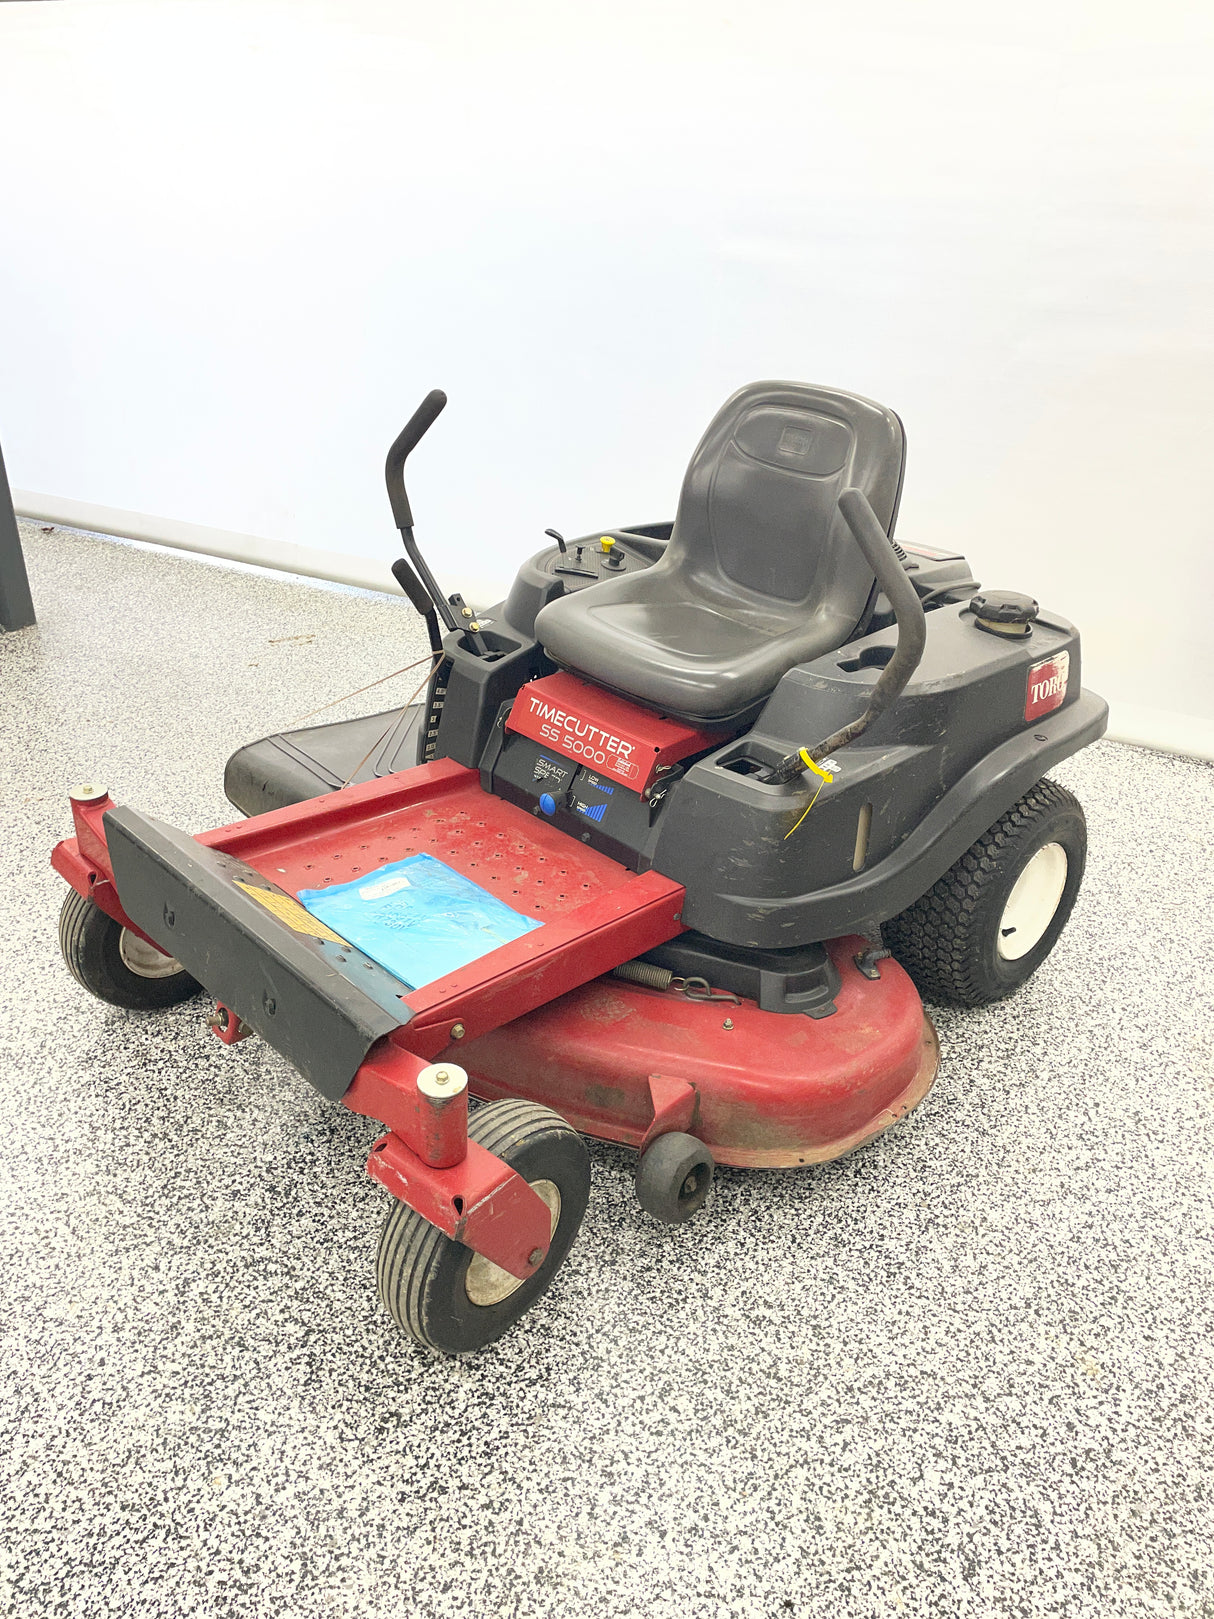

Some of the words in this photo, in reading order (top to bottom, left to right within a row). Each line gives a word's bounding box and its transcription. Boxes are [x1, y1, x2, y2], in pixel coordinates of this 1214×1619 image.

[529, 697, 631, 760] TIMECUTTER
[539, 723, 561, 742] SS
[562, 734, 606, 764] 5000
[536, 758, 568, 778] SMART
